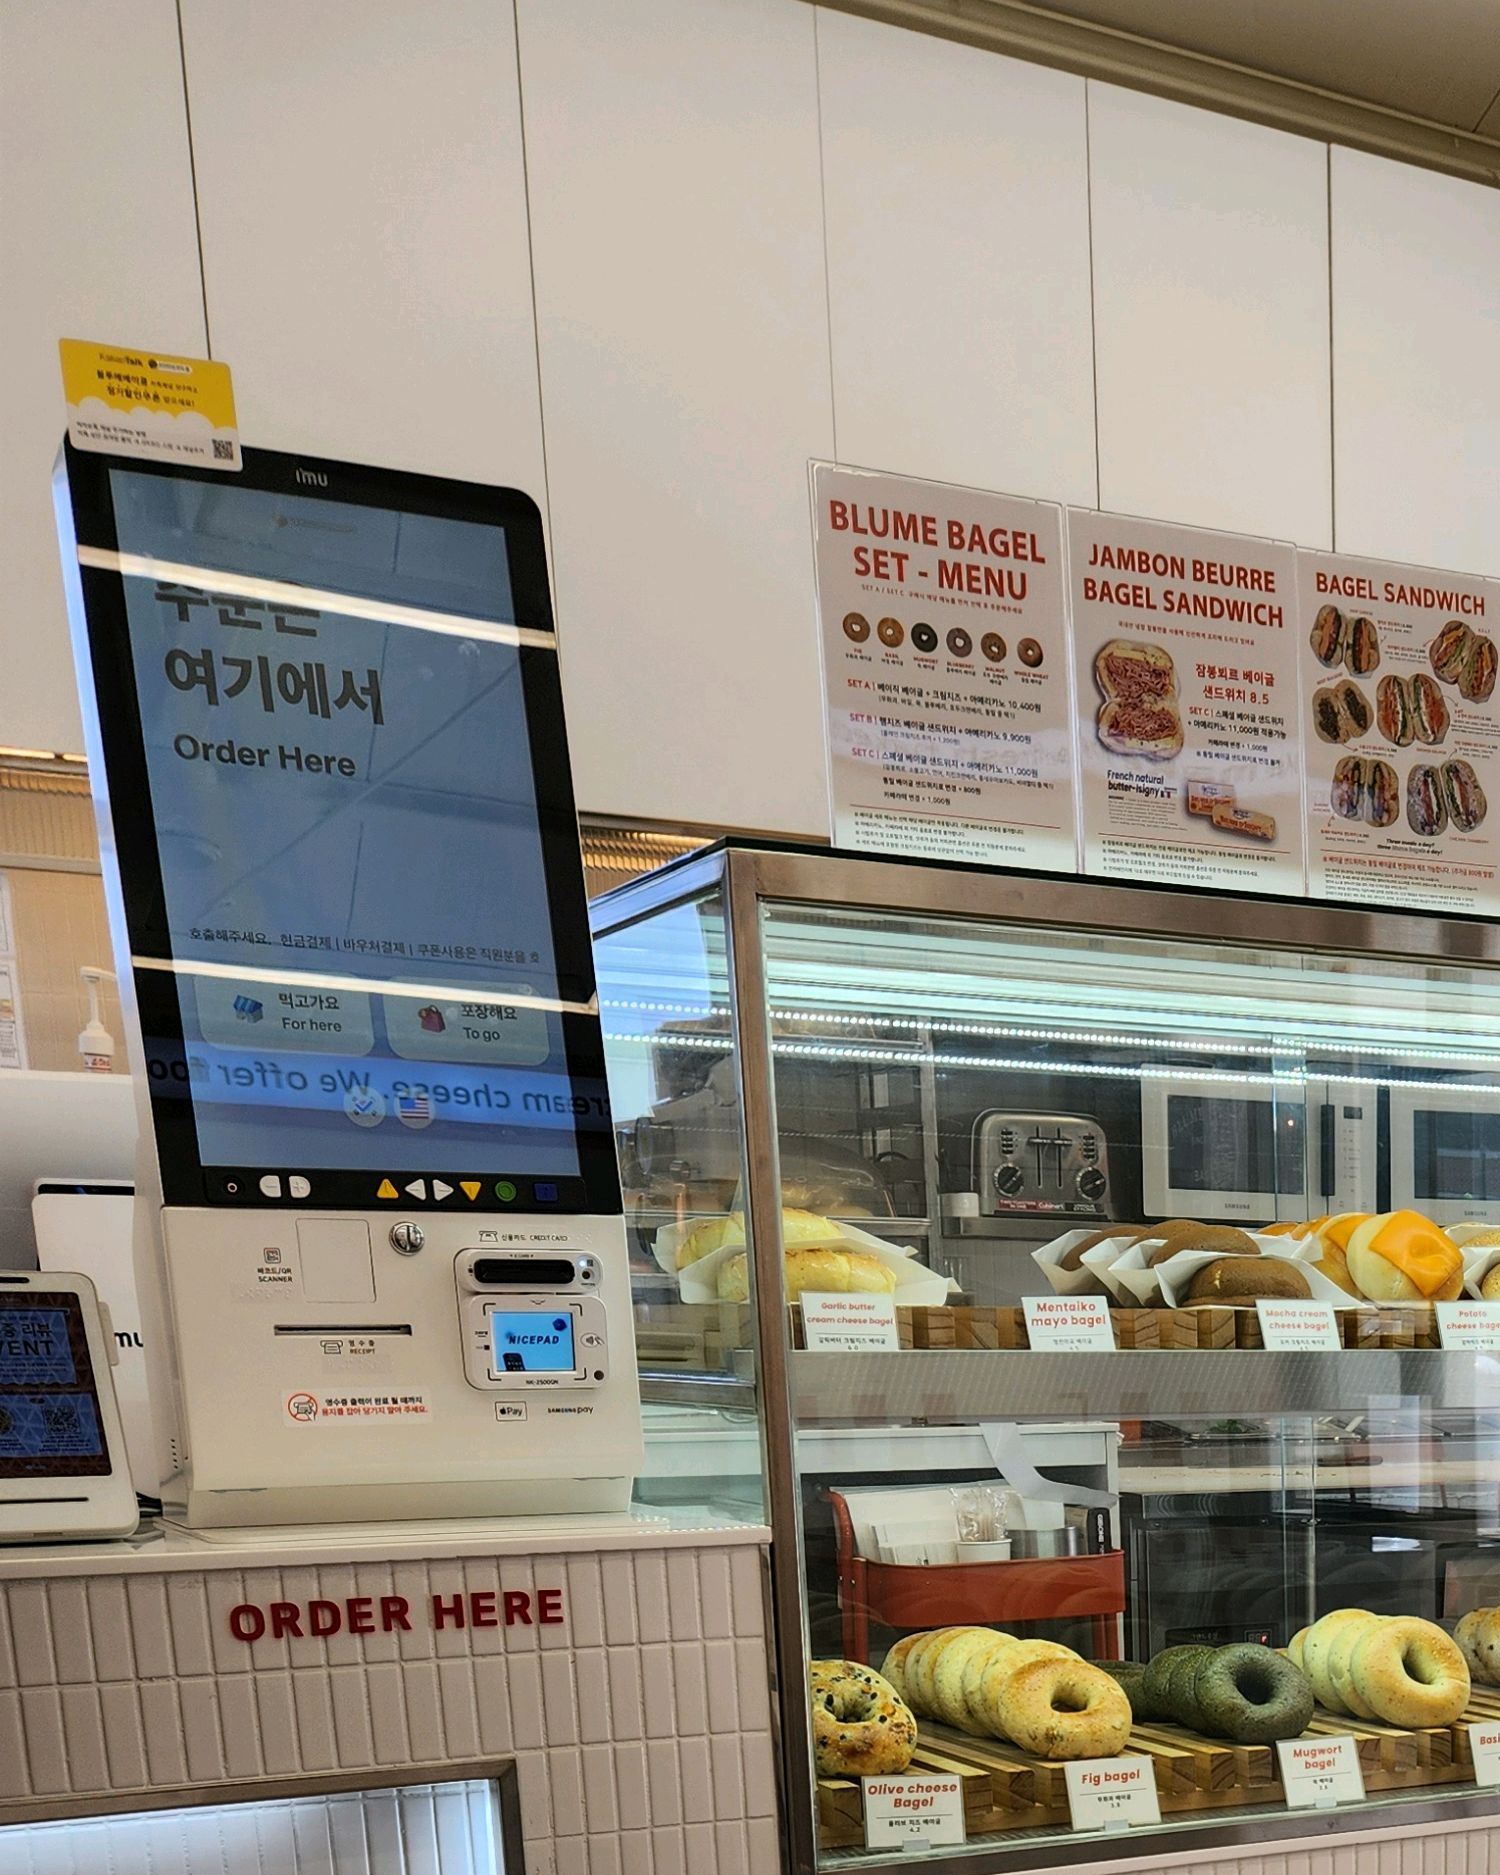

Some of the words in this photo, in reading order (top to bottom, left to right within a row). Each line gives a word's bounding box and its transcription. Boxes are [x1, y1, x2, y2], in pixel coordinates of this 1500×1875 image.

[830, 499, 938, 547] BLUME
[947, 520, 1046, 564] BAGEL
[854, 546, 909, 582] SET
[938, 559, 1026, 601] MENU
[1089, 543, 1185, 580] JAMBON
[1193, 559, 1276, 593] BEURRE
[1084, 577, 1157, 610] BAGEL
[1163, 589, 1284, 628] SANDWICH
[1316, 572, 1378, 600] BAGEL
[1384, 582, 1485, 616] SANDWICH
[1195, 663, 1239, 681] 잠봉뵈르
[1242, 669, 1275, 687] 베이글
[164, 649, 384, 725] 여기에서
[848, 679, 862, 688] SET
[864, 681, 870, 690] A
[901, 686, 923, 698] 베이글
[969, 695, 1006, 708] 아메리카노
[1203, 685, 1246, 703] 샌드위치
[1250, 692, 1270, 705] 8.5
[1189, 706, 1202, 715] SET
[1204, 708, 1209, 716] C
[1237, 713, 1256, 723] 베이글
[850, 713, 866, 722] SET
[866, 715, 872, 723] B
[903, 720, 925, 731] 베이글
[927, 723, 956, 735] 샌드위치
[964, 727, 1000, 741] 아메리카노
[1193, 720, 1226, 731] 아메리카노
[1228, 724, 1259, 736] 11,000원
[174, 734, 269, 767] Order
[278, 746, 356, 776] Here
[852, 747, 867, 757] SET
[868, 749, 874, 758] C
[905, 753, 927, 764] 베이글
[929, 756, 958, 768] 샌드위치
[967, 762, 1002, 773] 아메리카노
[1107, 769, 1134, 781] French
[1135, 773, 1164, 784] natural
[190, 928, 272, 946] 호출해주세요.
[418, 944, 477, 960] 쿠폰사용은
[481, 948, 526, 964] 직원분을
[278, 993, 340, 1010] 먹고가요
[461, 1004, 518, 1021] 포장해요
[282, 1017, 306, 1030] For
[310, 1018, 342, 1033] here
[463, 1027, 480, 1039] To
[483, 1029, 500, 1043] go
[821, 1302, 847, 1311] Garlic
[849, 1302, 876, 1312] butter
[1037, 1301, 1096, 1313] Mentaiko
[1298, 1310, 1328, 1318] cream
[807, 1317, 835, 1325] cream
[837, 1316, 868, 1326] cheese
[869, 1317, 893, 1328] bagel
[1031, 1317, 1068, 1328] mayo
[1070, 1315, 1106, 1328] bagel
[1304, 1322, 1330, 1332] bagel
[509, 1335, 560, 1345] NICEPAD
[507, 1407, 523, 1417] Pay
[577, 1407, 593, 1415] pay
[229, 1595, 412, 1642] ORDER
[432, 1589, 564, 1630] HERE
[1293, 1744, 1342, 1759] Mugwort
[1304, 1758, 1336, 1770] bagel
[1081, 1772, 1100, 1786] Fig
[1103, 1769, 1140, 1783] bagel
[868, 1783, 905, 1796] Olive
[908, 1781, 957, 1795] cheese
[893, 1796, 934, 1810] Bagel
